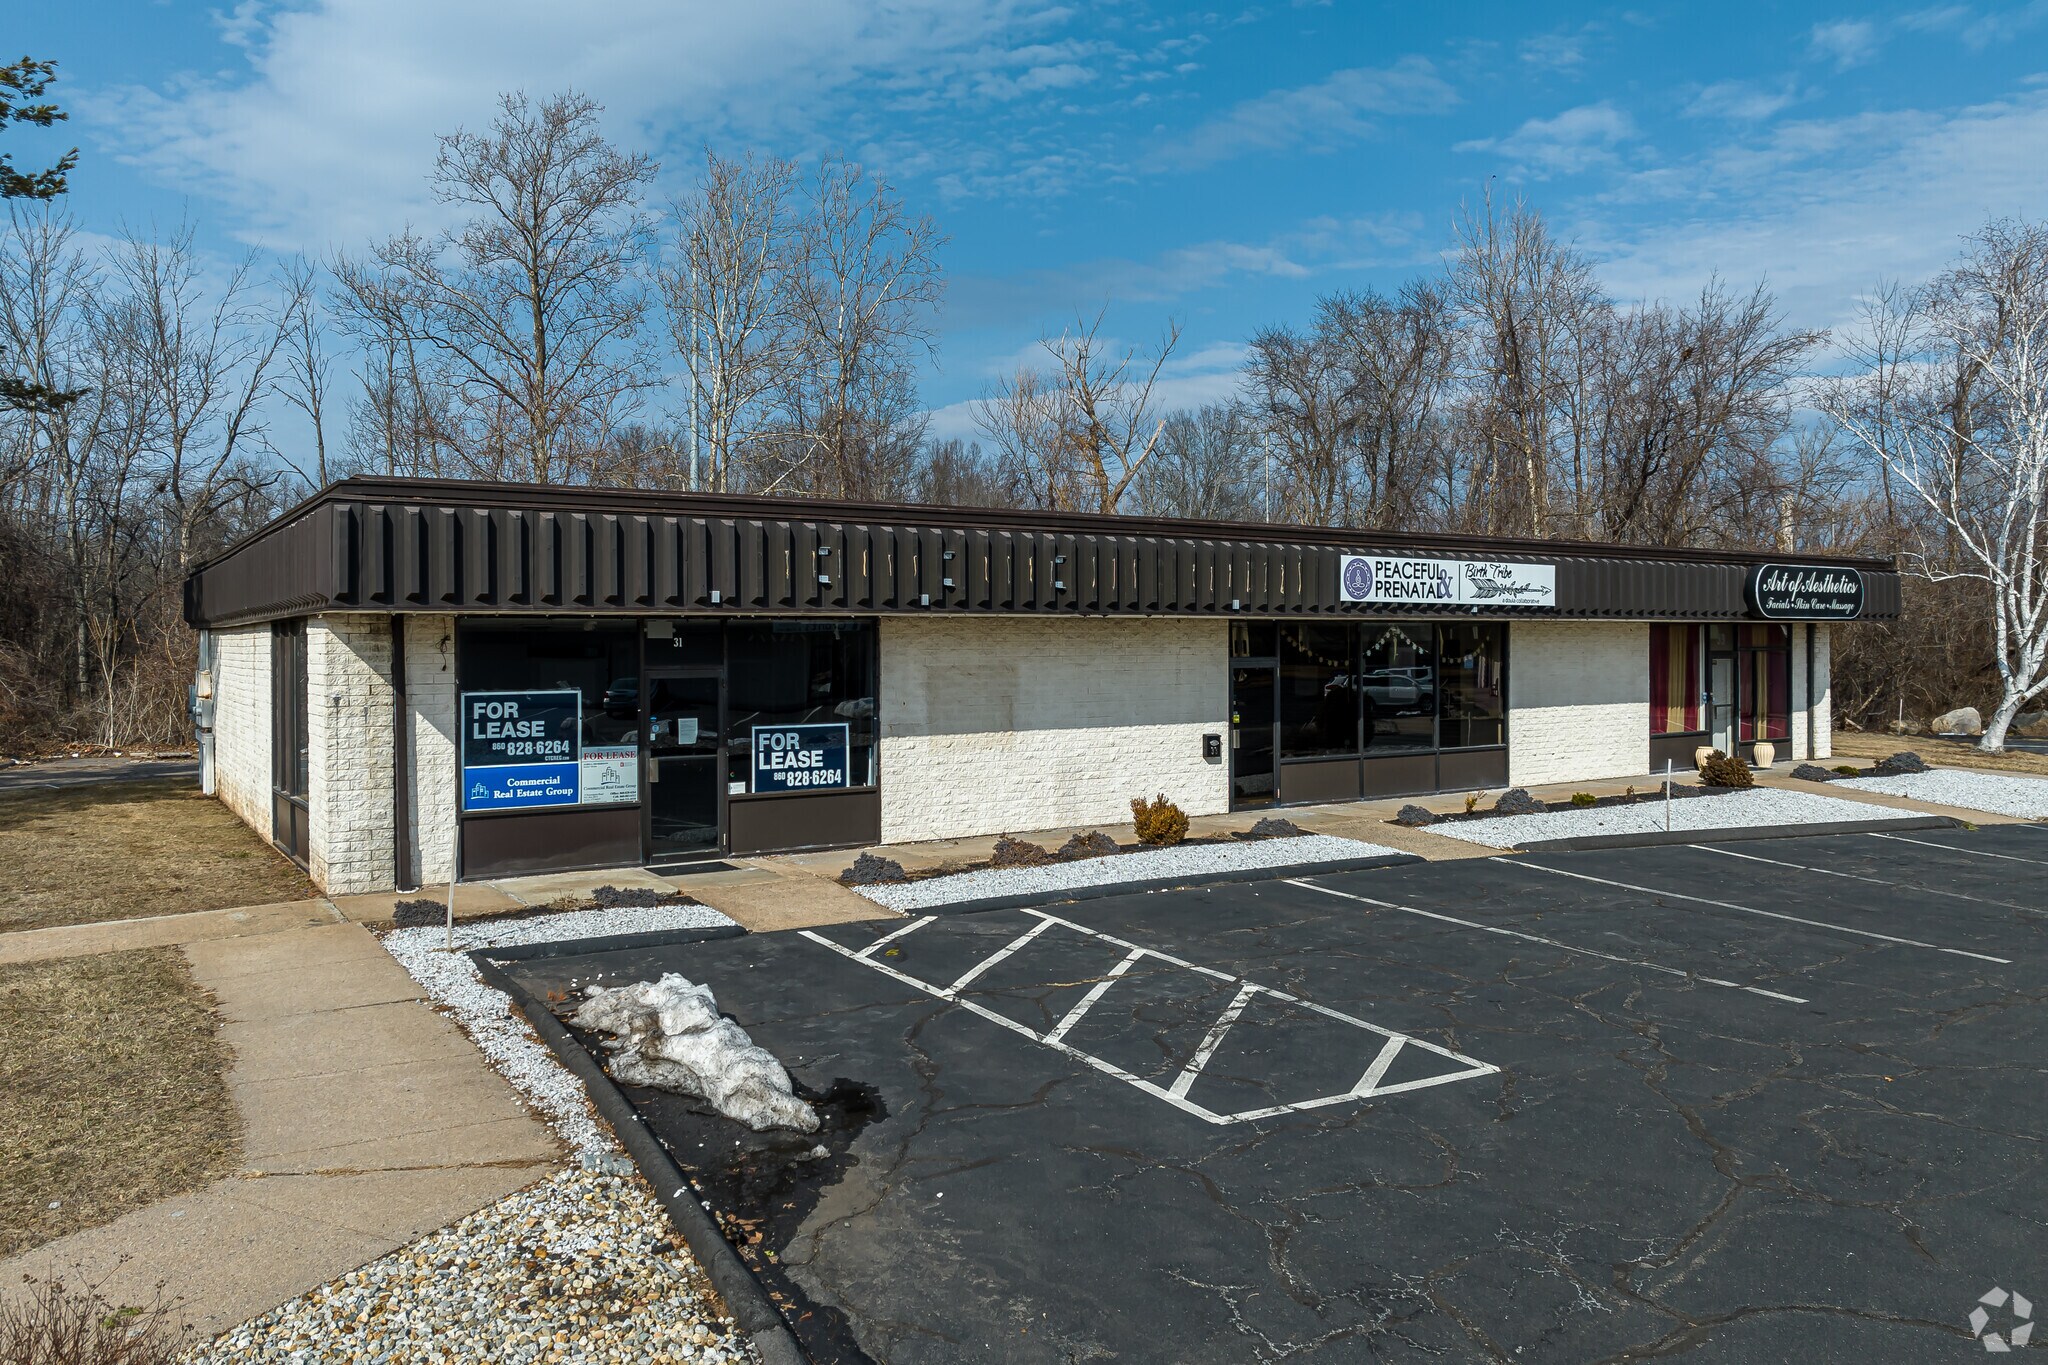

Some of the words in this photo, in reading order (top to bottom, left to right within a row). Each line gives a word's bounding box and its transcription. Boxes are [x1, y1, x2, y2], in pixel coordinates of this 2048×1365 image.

[1375, 561, 1442, 580] PEACEFUL
[1465, 563, 1487, 578] Birth
[1490, 563, 1512, 579] Tribe
[1375, 581, 1442, 599] PRENATAL
[1763, 570, 1789, 592] Art
[1788, 571, 1803, 601] of
[1801, 571, 1859, 594] Aesthetics
[1766, 597, 1790, 609] Facials
[1794, 598, 1810, 609] Skin
[1811, 599, 1826, 610] Care
[1829, 599, 1855, 614] Massage
[673, 637, 683, 648] 31
[473, 702, 519, 719] FOR
[473, 720, 545, 739] LEASE
[492, 742, 506, 750] 860
[507, 740, 570, 756] 828-6264
[758, 733, 800, 751] FOR
[583, 752, 603, 760] FOR
[606, 751, 637, 759] LEASE
[758, 750, 823, 770] LEASE
[507, 776, 560, 787] Commercial
[773, 772, 786, 781] 860
[786, 769, 842, 787] 828-6264
[493, 789, 514, 798] Real
[516, 788, 543, 798] Estate
[546, 787, 573, 796] Group
